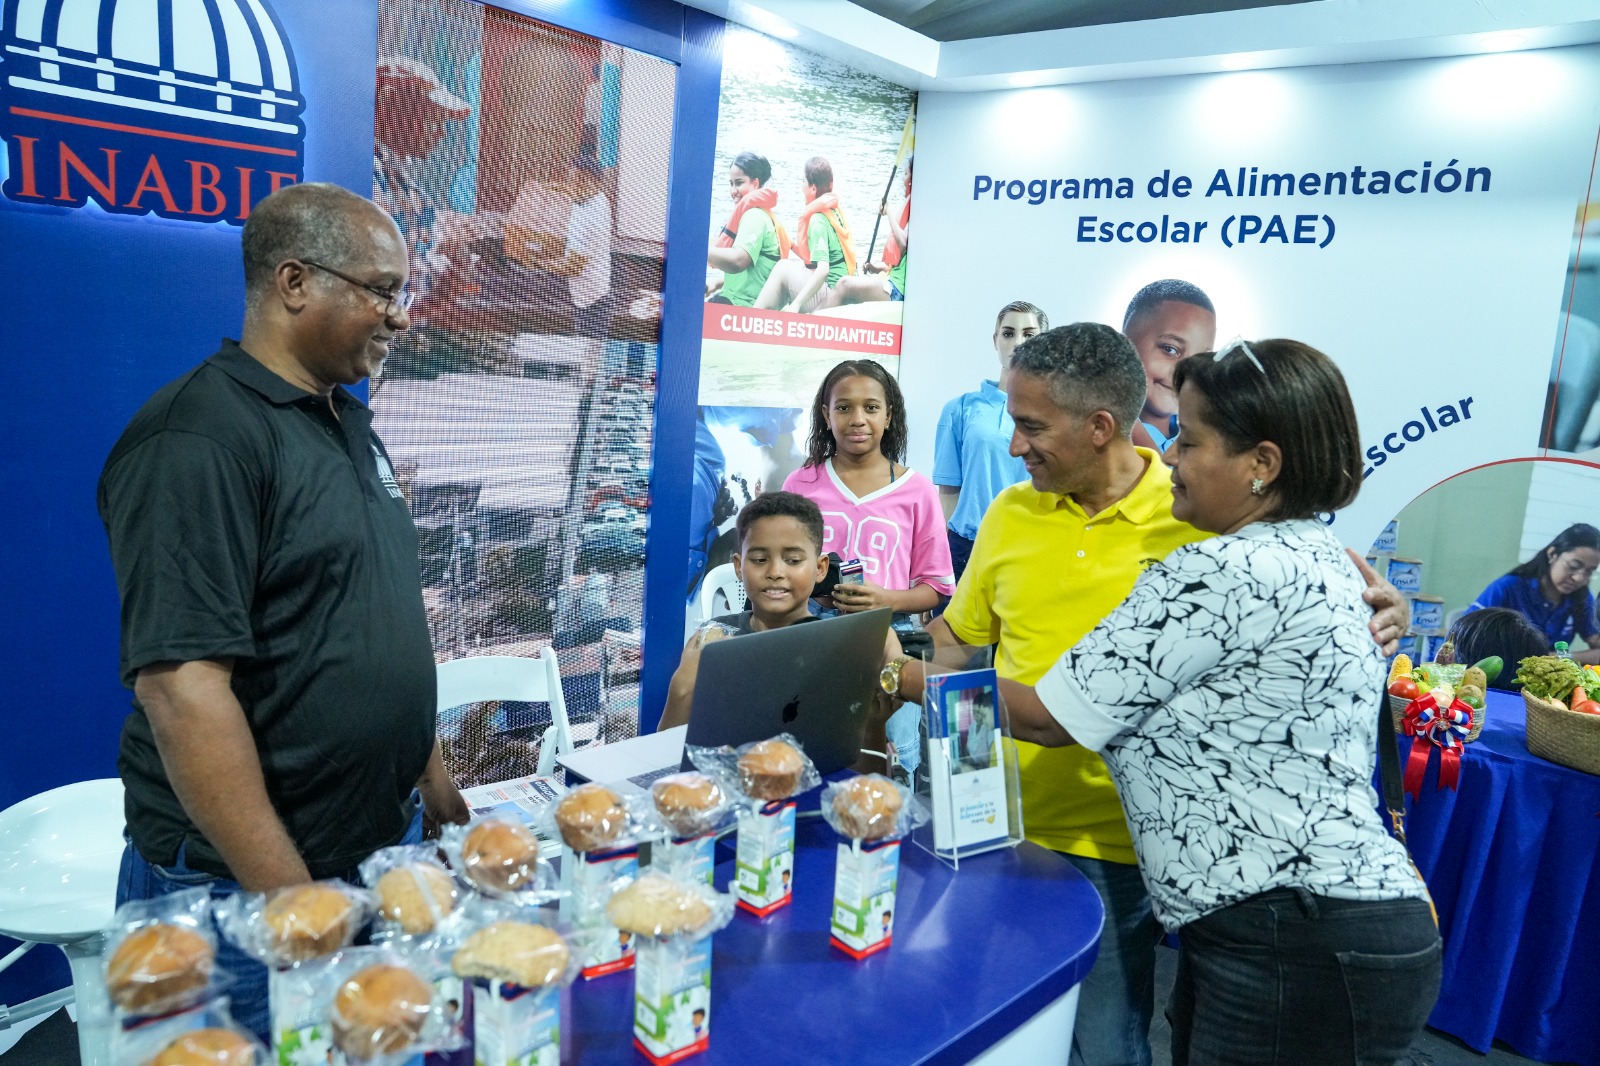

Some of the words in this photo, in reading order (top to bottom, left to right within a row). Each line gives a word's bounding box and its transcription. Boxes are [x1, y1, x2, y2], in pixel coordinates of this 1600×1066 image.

[973, 175, 1134, 205] Programa
[1147, 170, 1193, 198] de
[1205, 159, 1492, 198] Alimentación
[1077, 214, 1208, 243] Escolar
[1221, 214, 1336, 249] (PAE)
[720, 314, 783, 336] CLUBES
[787, 322, 894, 347] ESTUDIANTILES
[1363, 396, 1474, 480] scolar
